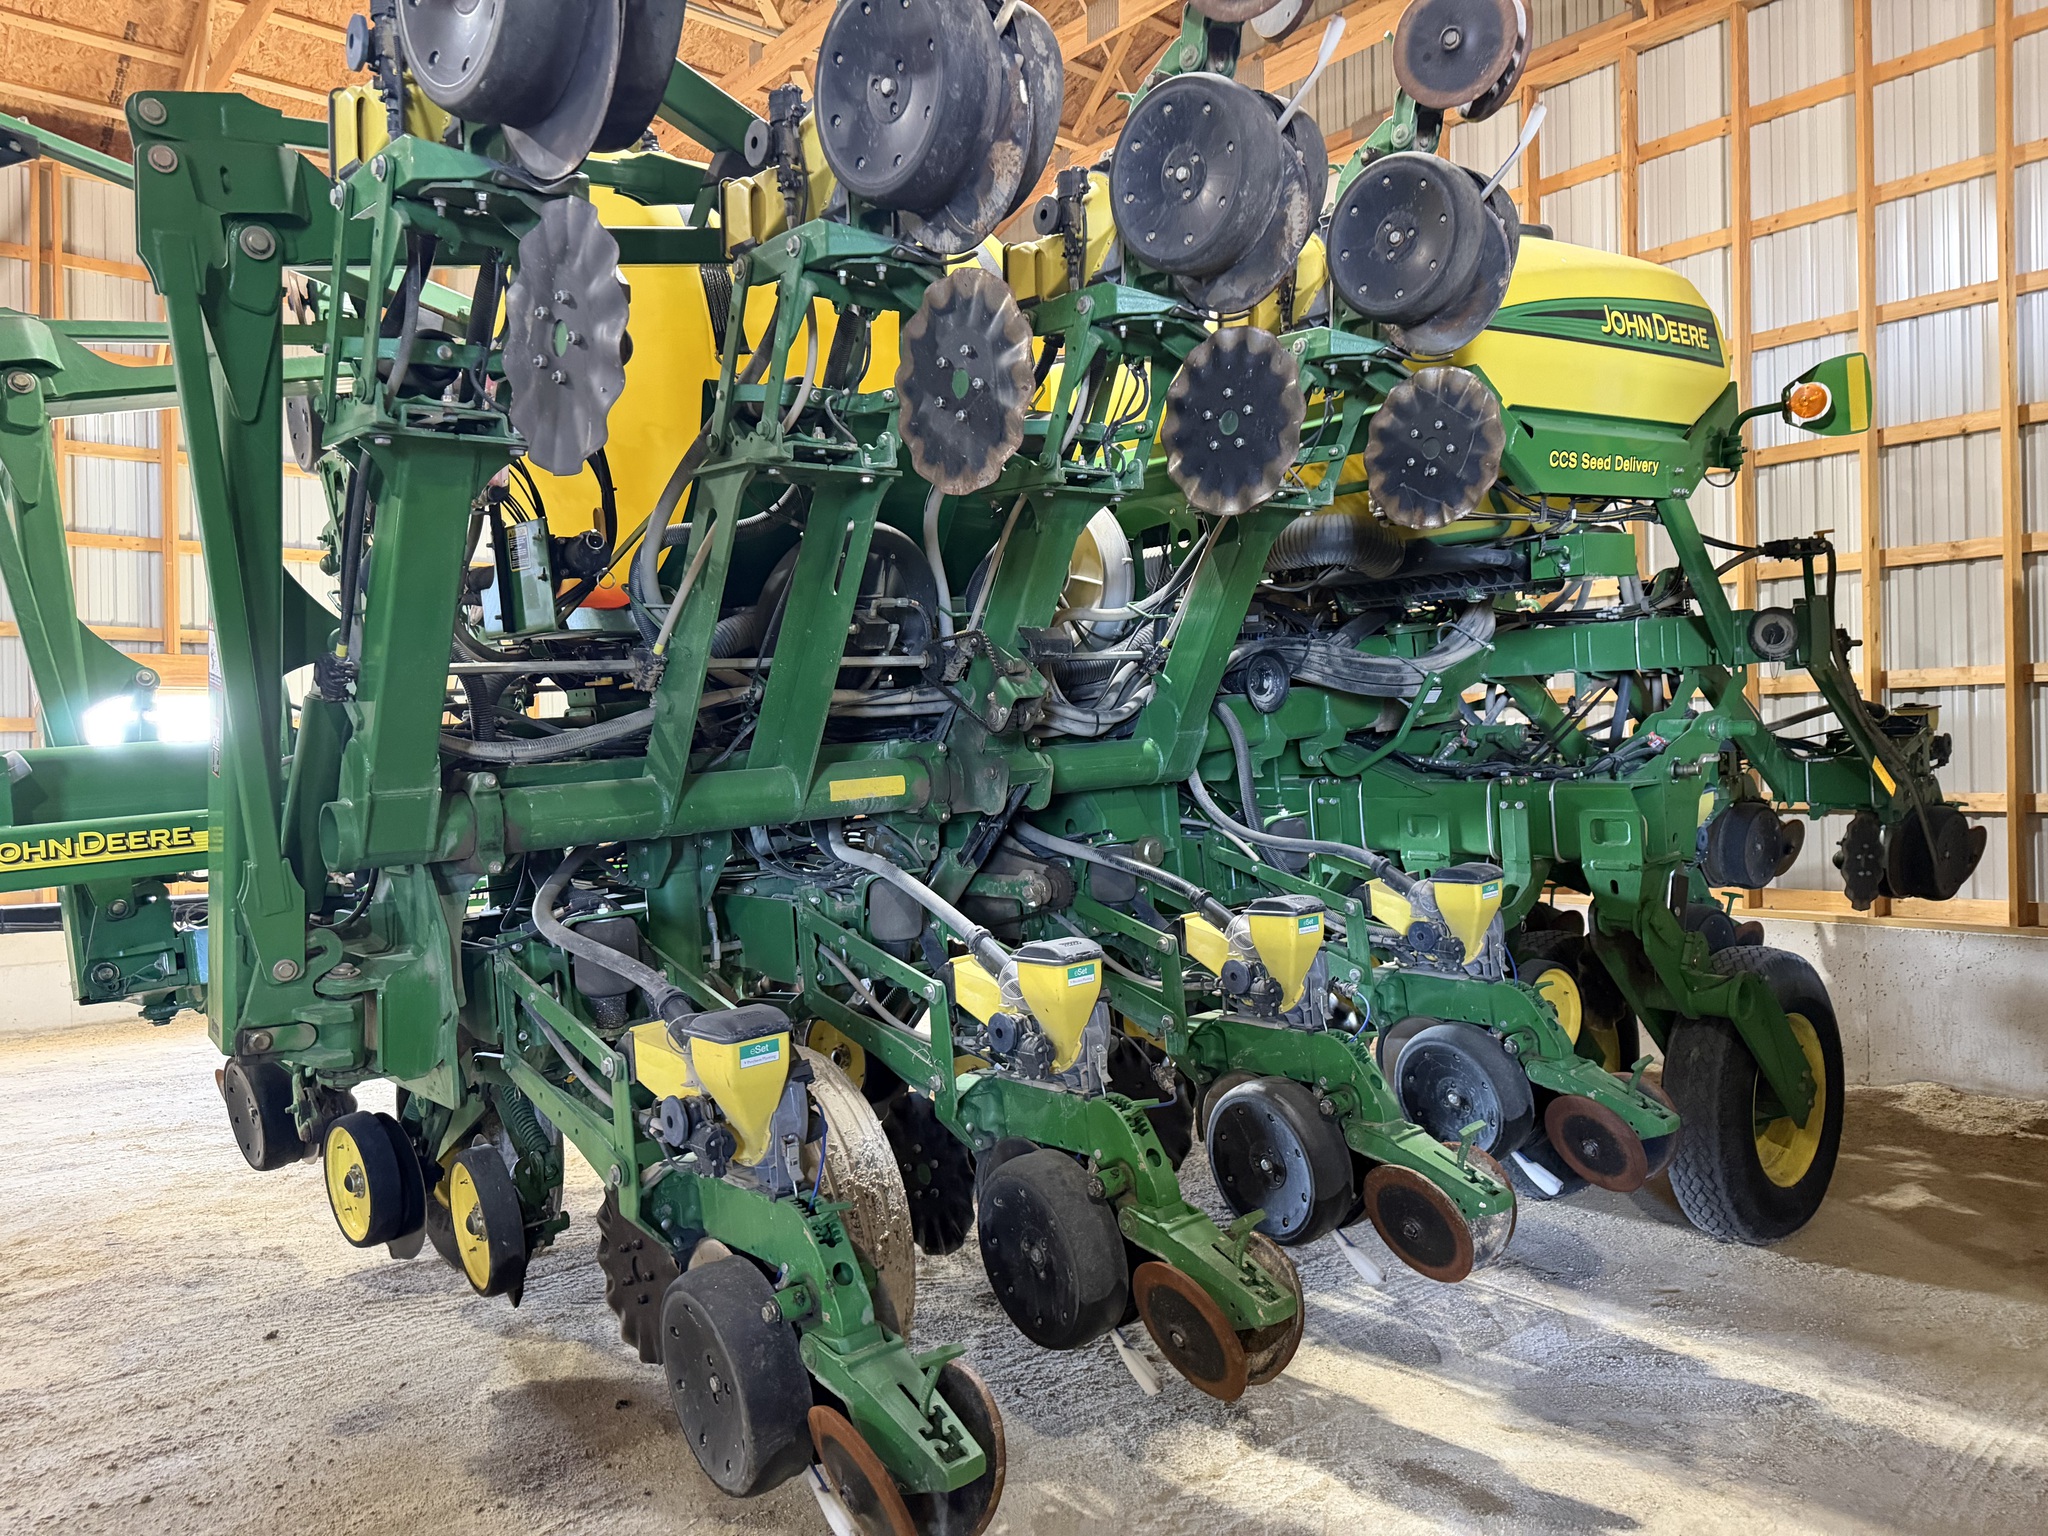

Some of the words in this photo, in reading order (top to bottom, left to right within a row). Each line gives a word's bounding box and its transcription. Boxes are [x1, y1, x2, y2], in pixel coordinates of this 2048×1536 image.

[1600, 304, 1654, 340] JOHN
[1651, 312, 1710, 351] DEERE
[1549, 450, 1578, 469] CCS
[1581, 452, 1612, 471] Seed
[1614, 455, 1660, 477] Delivery
[0, 837, 74, 864] OHN
[77, 826, 193, 856] DEERE
[750, 1043, 770, 1055] eSet
